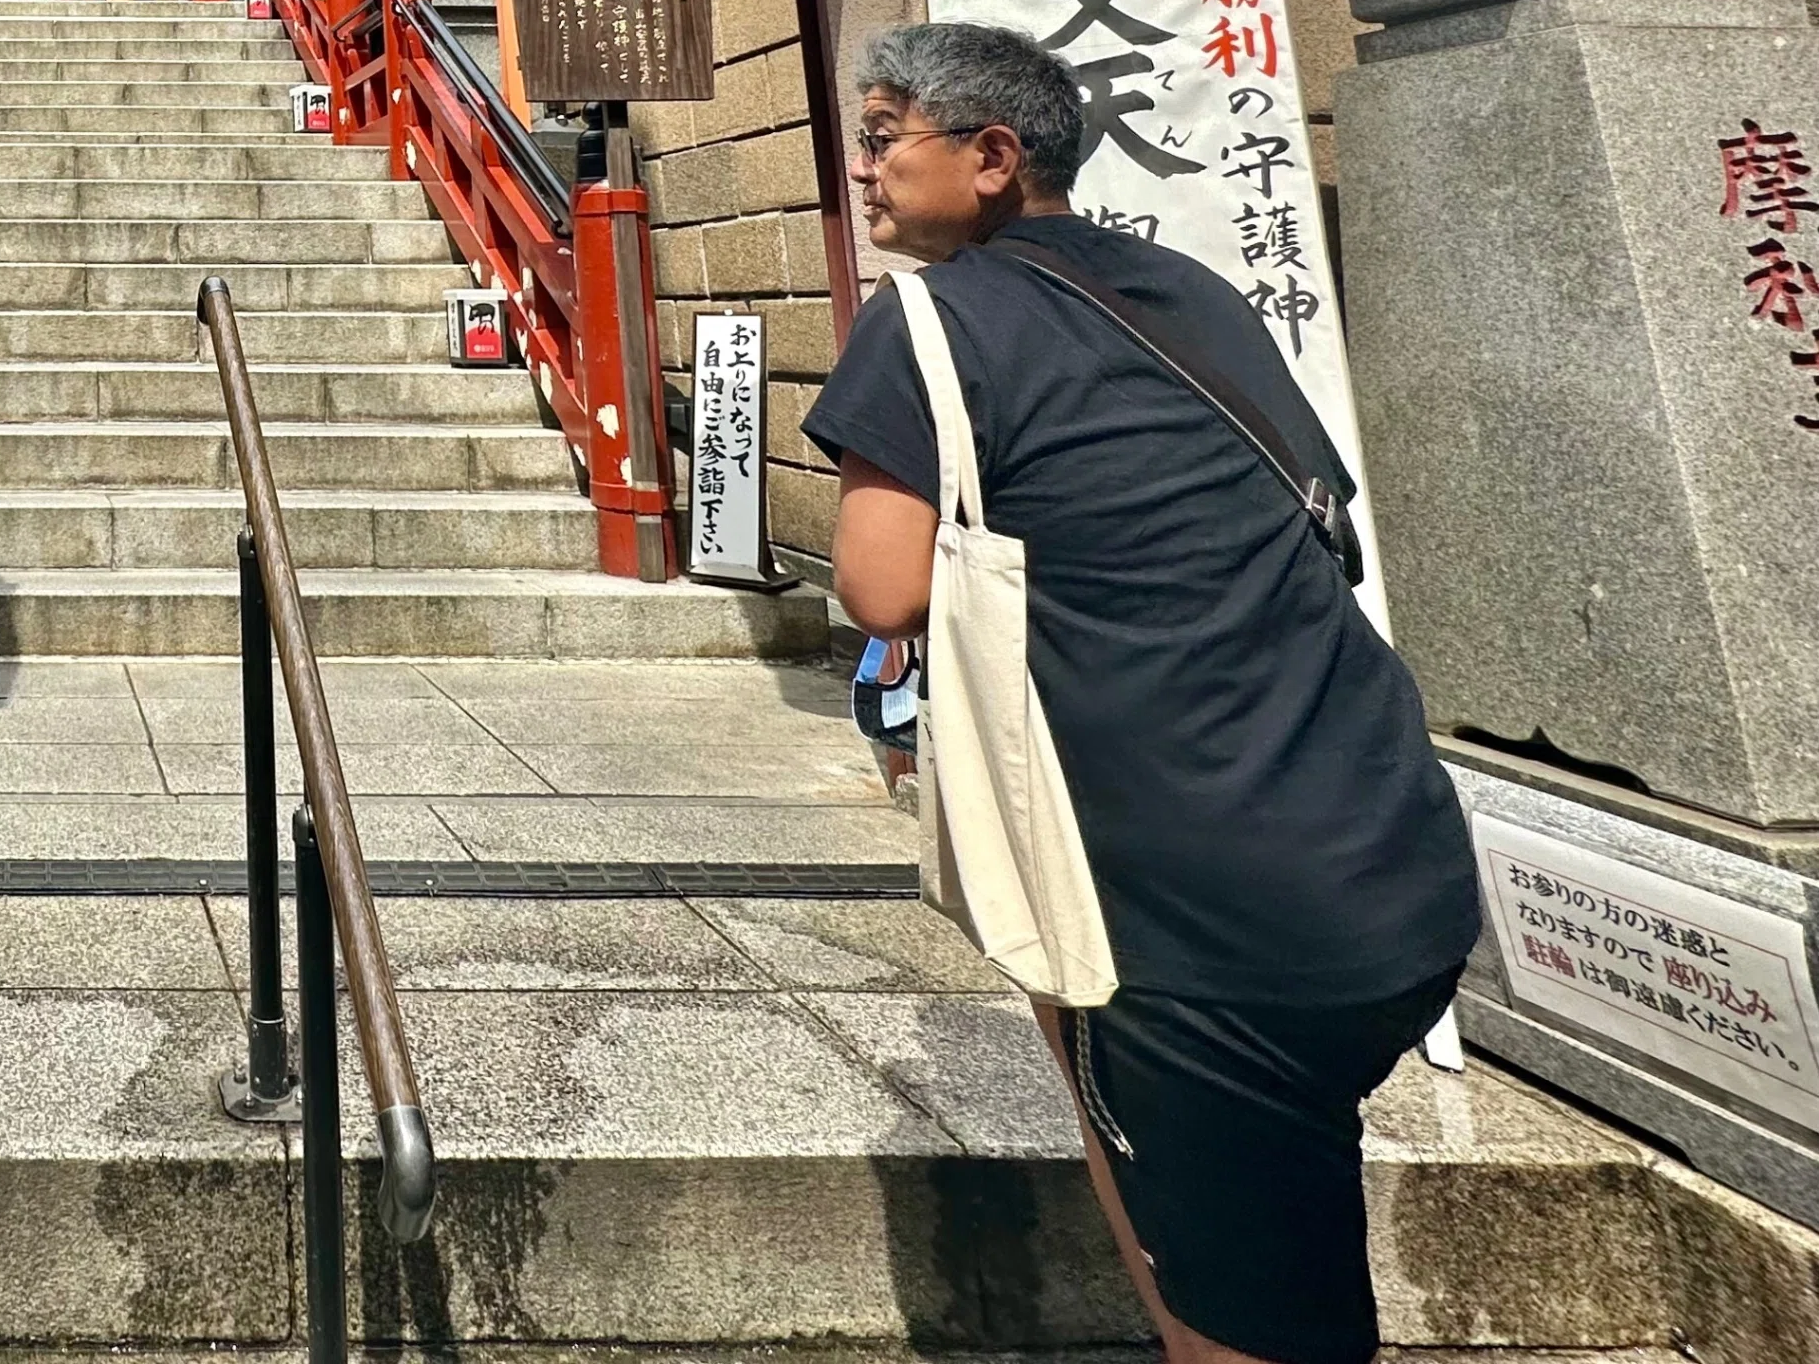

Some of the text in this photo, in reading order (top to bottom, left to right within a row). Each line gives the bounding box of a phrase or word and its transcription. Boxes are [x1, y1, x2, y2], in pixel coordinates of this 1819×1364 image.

[697, 340, 728, 555] 自由にご参詣下さい
[727, 324, 757, 478] お上りになって
[1509, 863, 1731, 968] お参りの方の迷惑と
